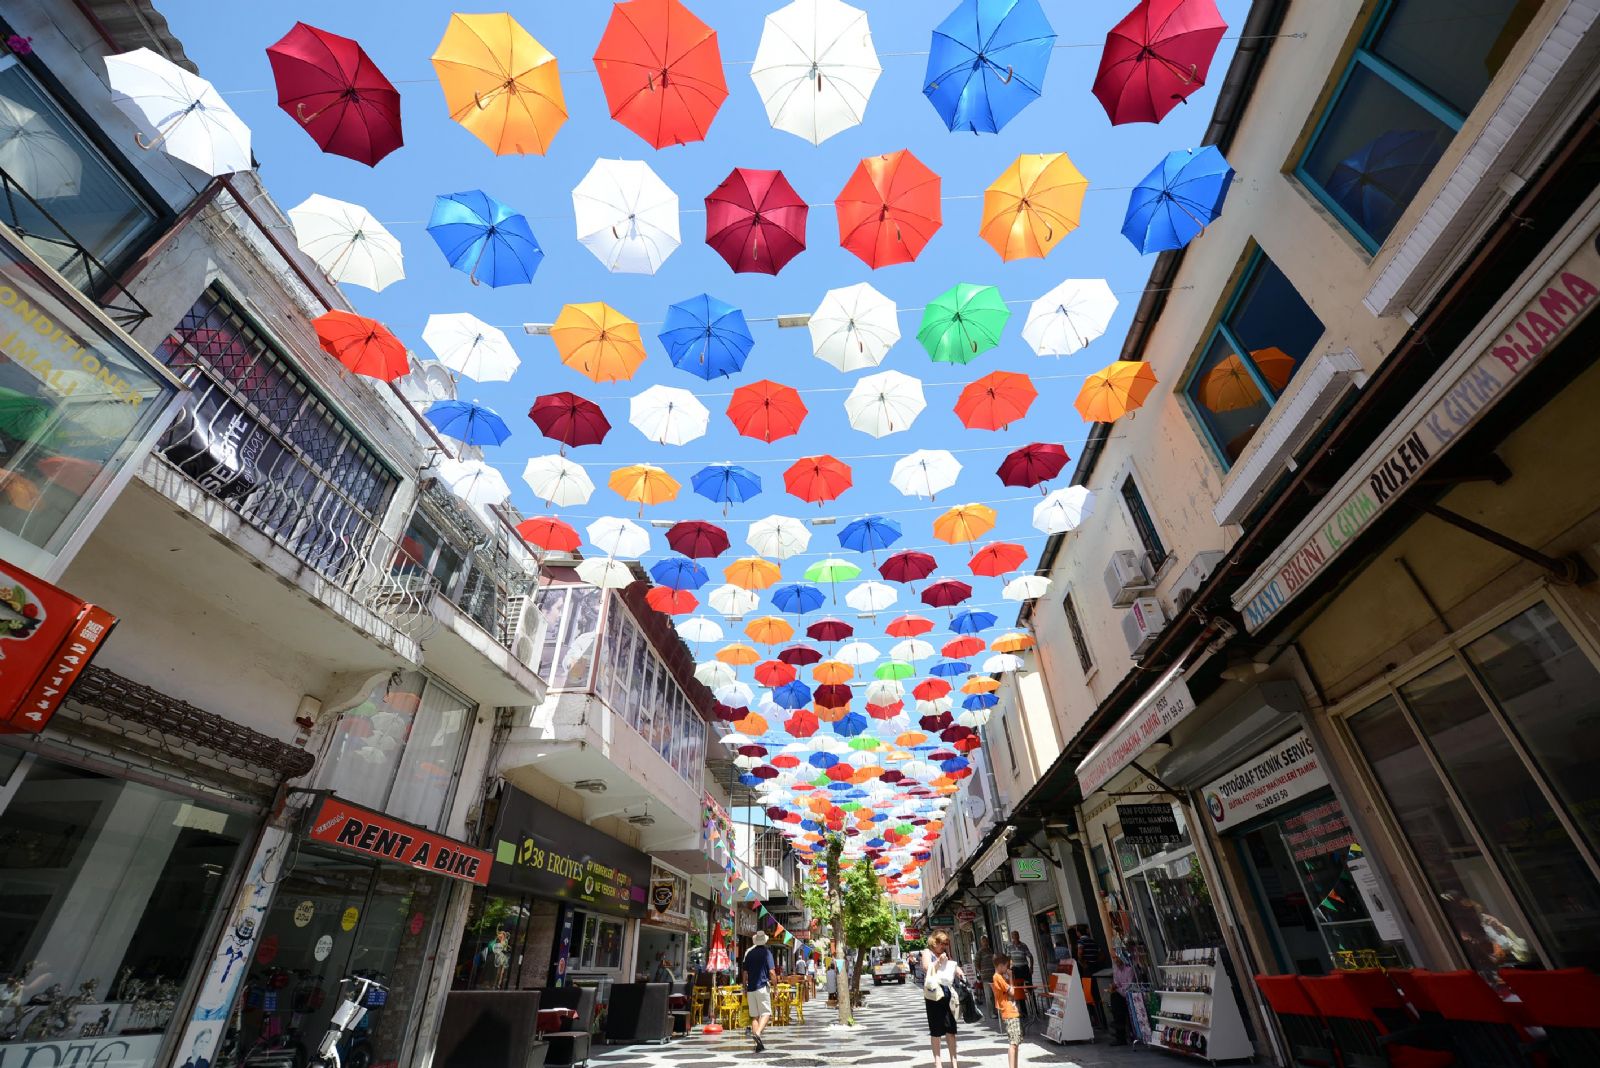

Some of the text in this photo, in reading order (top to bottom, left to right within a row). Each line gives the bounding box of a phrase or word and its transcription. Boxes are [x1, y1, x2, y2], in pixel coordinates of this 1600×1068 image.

[1246, 579, 1285, 628] MAYO
[1219, 768, 1255, 797] FOTOĞRAF
[1253, 754, 1284, 782] TEKNİK
[336, 816, 413, 859] RENT
[412, 842, 430, 867] A
[530, 845, 544, 869] 38
